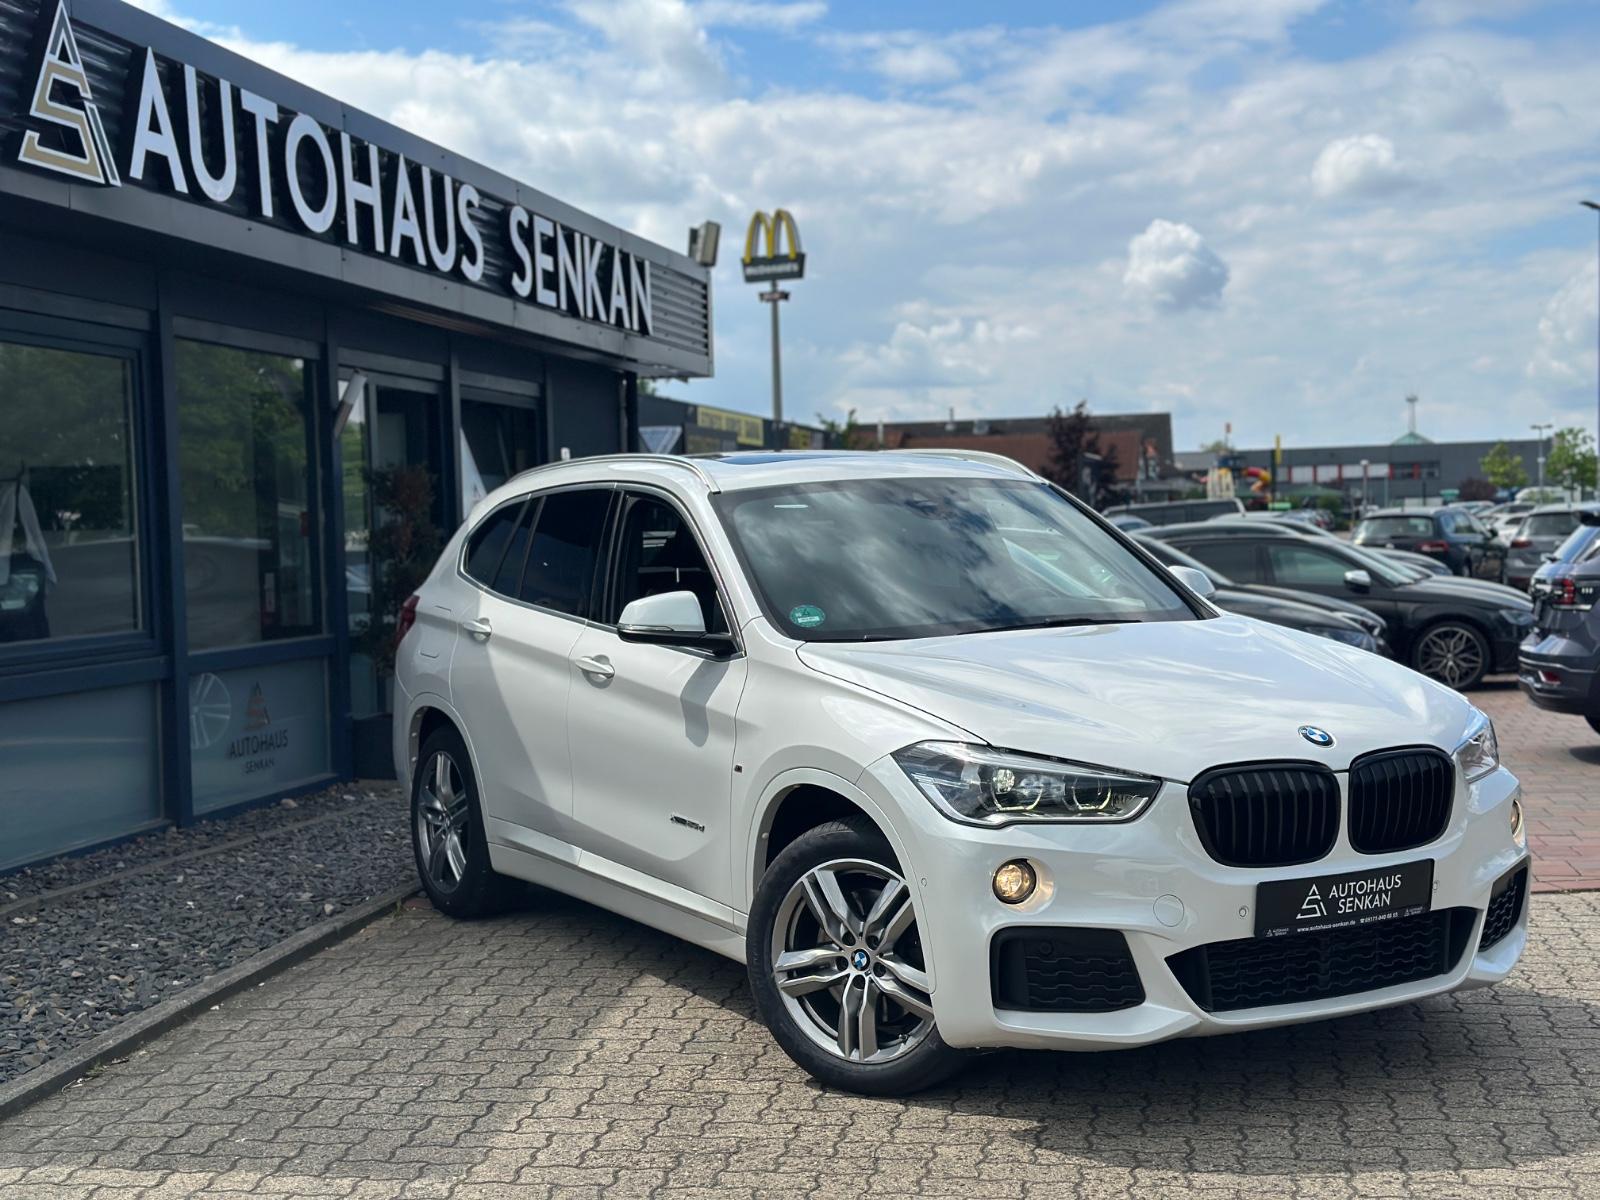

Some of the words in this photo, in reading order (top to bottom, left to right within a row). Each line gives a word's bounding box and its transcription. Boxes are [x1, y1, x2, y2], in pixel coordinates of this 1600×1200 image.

[129, 46, 485, 282] AUTOHAUS
[509, 204, 653, 336] SENKAN
[229, 728, 289, 759] AUTOHAUS
[1329, 874, 1402, 899] AUTOHAUS
[1337, 891, 1392, 914] SENKAN
